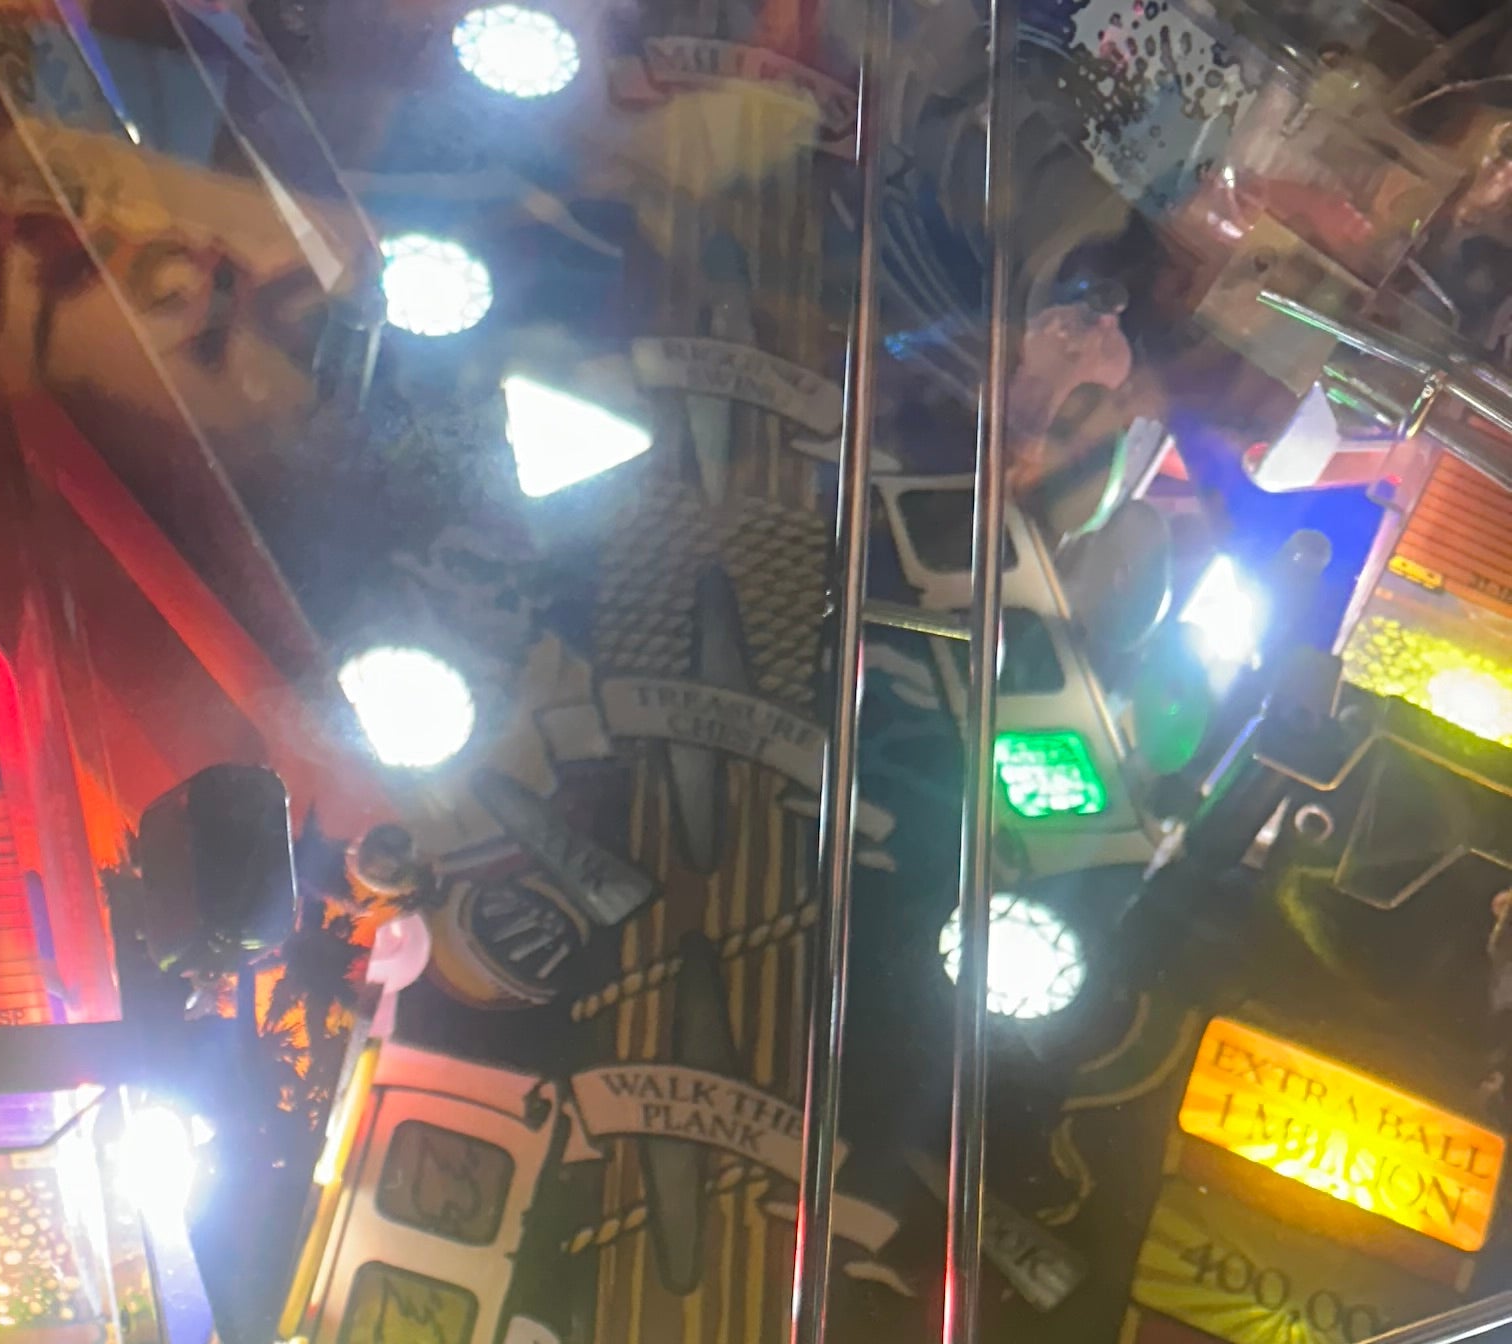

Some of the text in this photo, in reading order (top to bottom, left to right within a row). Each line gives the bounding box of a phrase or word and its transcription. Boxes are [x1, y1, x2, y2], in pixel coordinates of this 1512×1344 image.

[601, 1072, 802, 1139] WALK THE
[642, 1102, 766, 1152] PLANK
[1244, 1102, 1465, 1227] MILION
[1376, 1105, 1491, 1181] BALL
